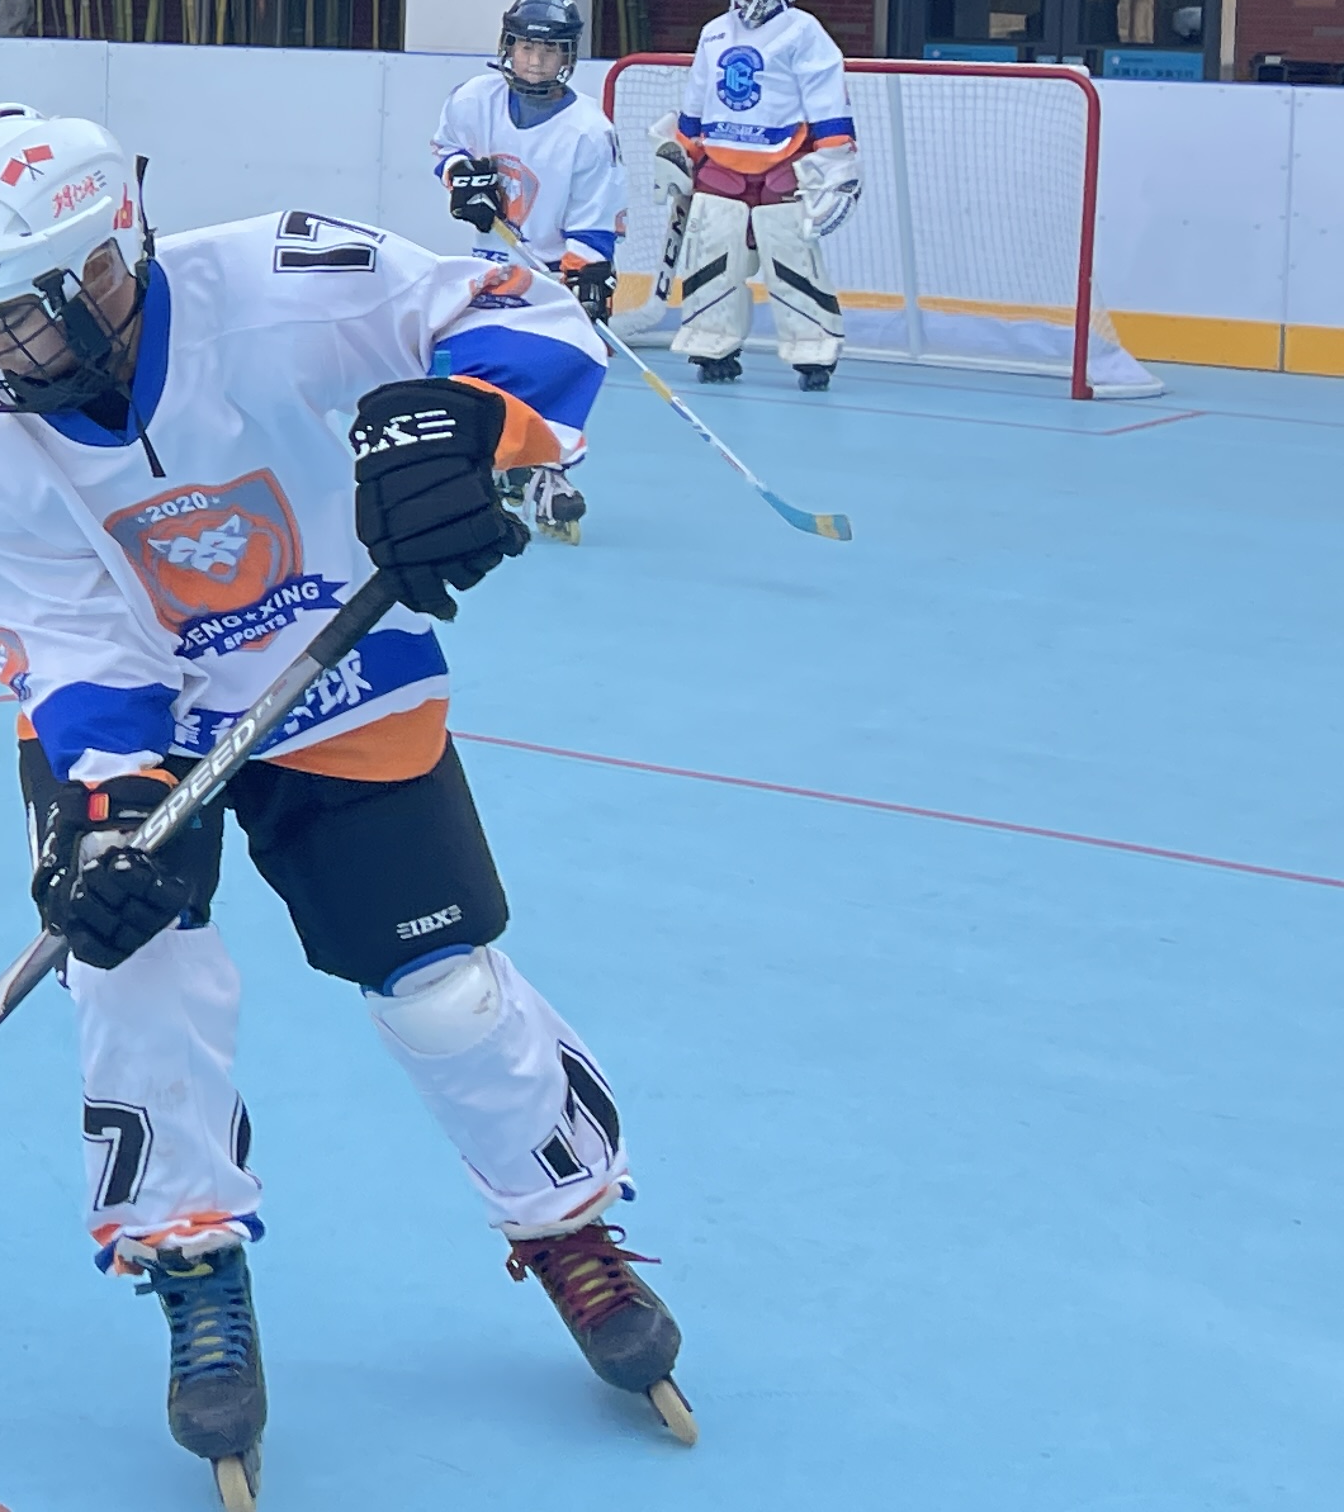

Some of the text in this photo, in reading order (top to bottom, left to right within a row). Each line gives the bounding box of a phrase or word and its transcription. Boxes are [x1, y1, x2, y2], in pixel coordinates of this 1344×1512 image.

[655, 205, 686, 301] CCM
[145, 491, 208, 523] 2020
[223, 614, 288, 650] SPORTS
